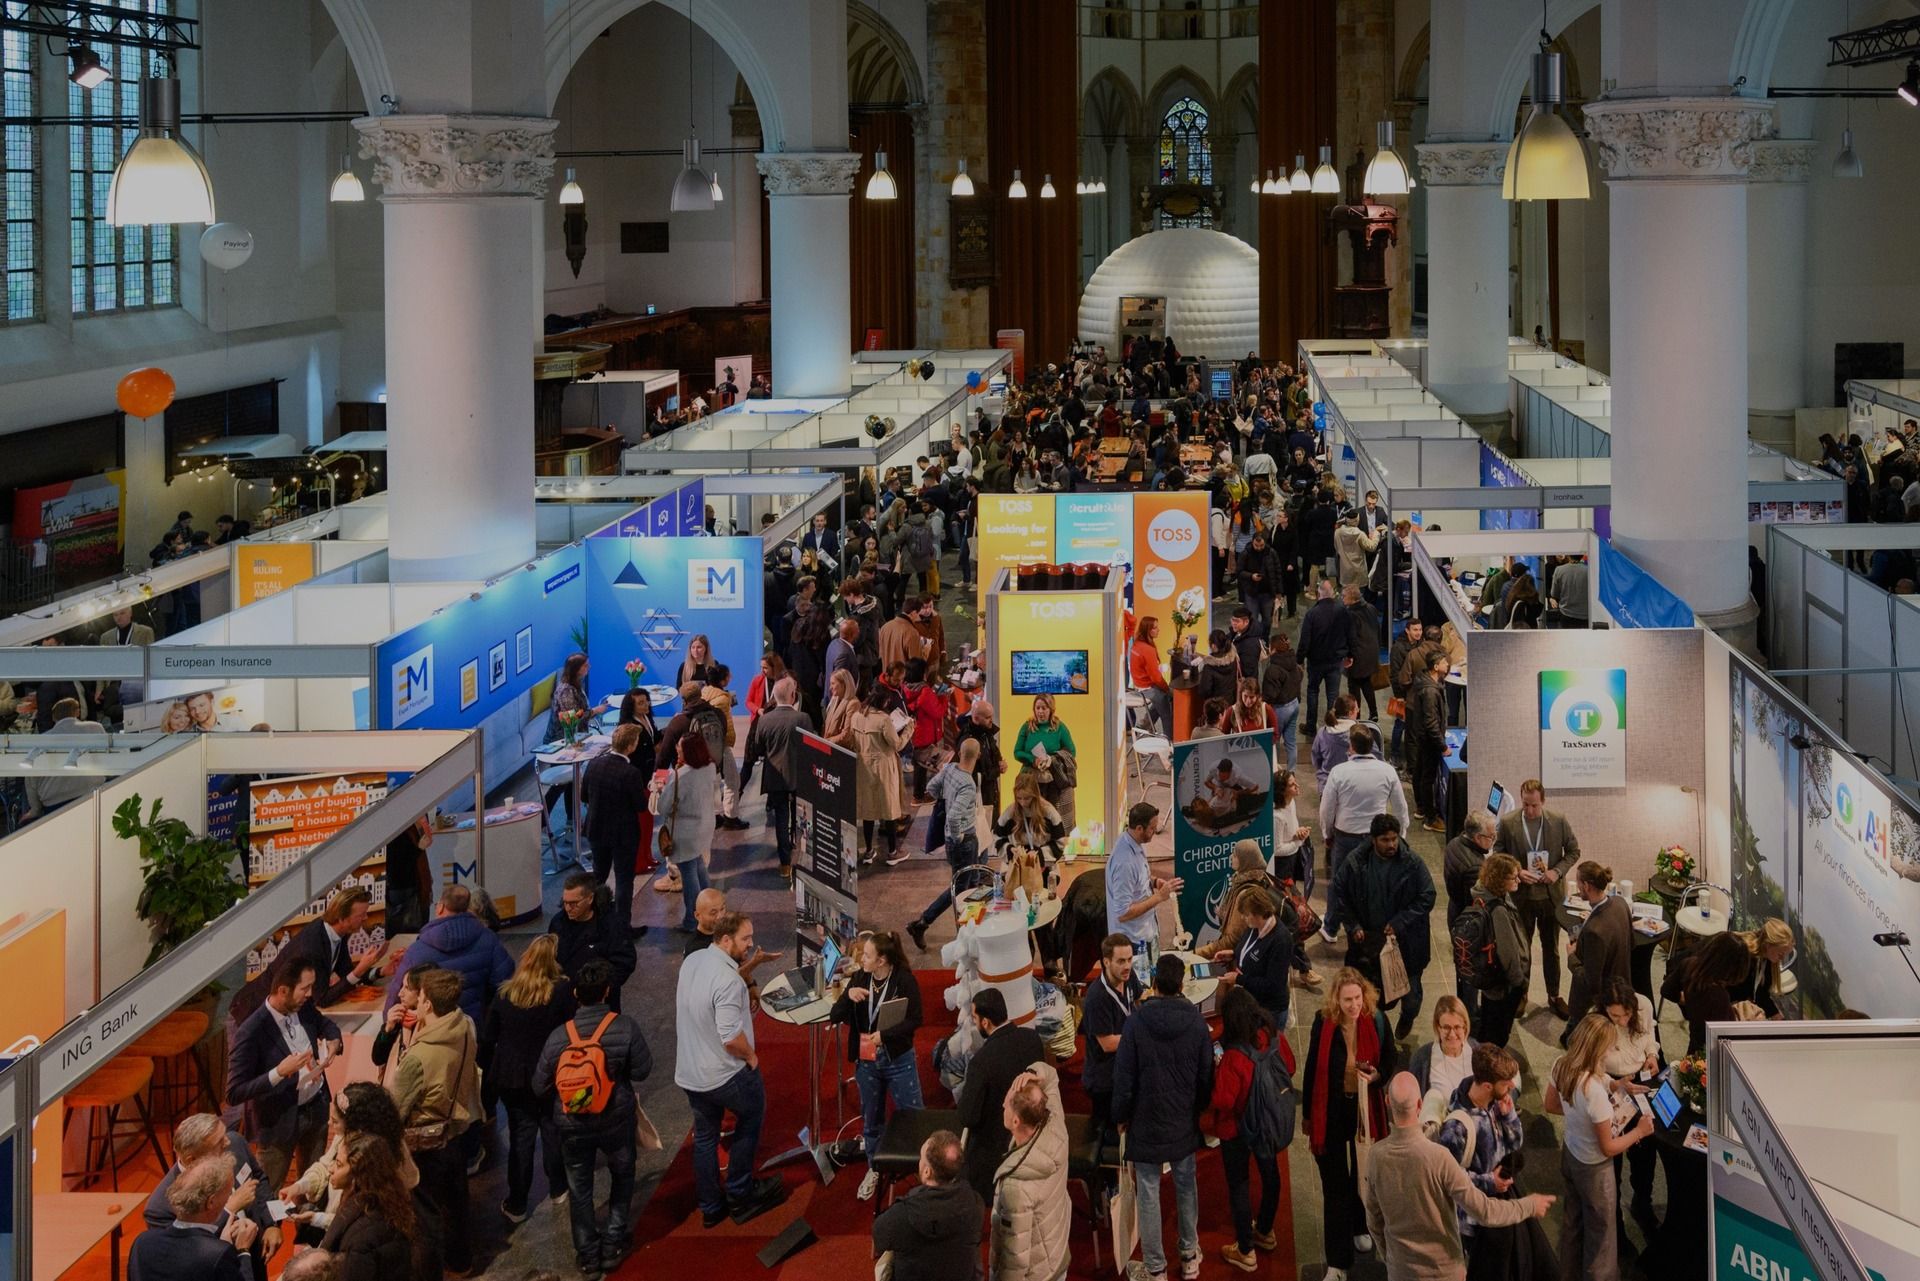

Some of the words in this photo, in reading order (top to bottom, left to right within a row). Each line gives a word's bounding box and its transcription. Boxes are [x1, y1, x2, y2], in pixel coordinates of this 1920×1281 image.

[999, 500, 1033, 513] TOSS
[986, 524, 1028, 536] Looking
[1031, 523, 1047, 533] for
[1153, 528, 1193, 541] TOSS
[1029, 602, 1074, 618] TOSS
[164, 657, 216, 669] European
[221, 657, 272, 667] Insurance
[1562, 741, 1607, 749] TaxSavers
[261, 801, 312, 816] Dreaming
[314, 798, 325, 809] of
[327, 794, 362, 809] buying
[297, 820, 304, 828] a
[306, 815, 337, 826] house
[340, 813, 349, 821] in
[279, 835, 296, 846] the
[1814, 839, 1824, 856] All
[1823, 849, 1839, 872] your
[1839, 863, 1867, 904] finances
[1867, 898, 1875, 912] in
[1875, 906, 1890, 929] one
[62, 1035, 93, 1070] ING
[101, 1003, 138, 1041] Bank
[1741, 1101, 1762, 1143] ABN
[1765, 1140, 1796, 1201] AMRO
[1730, 1243, 1791, 1281] ABN
